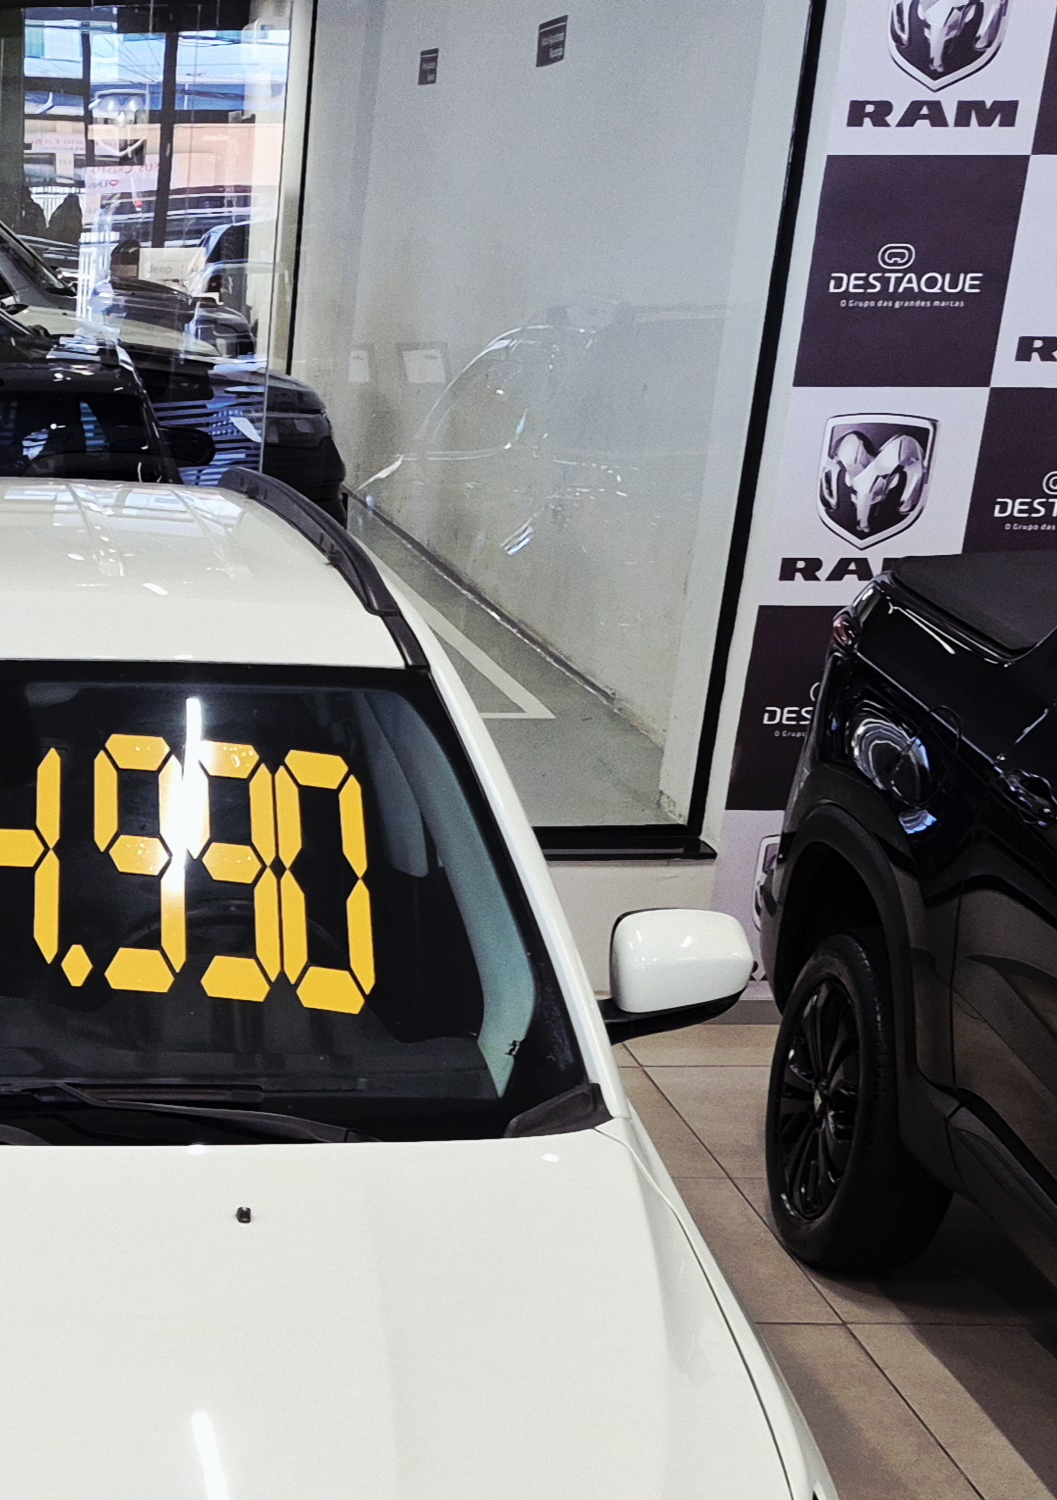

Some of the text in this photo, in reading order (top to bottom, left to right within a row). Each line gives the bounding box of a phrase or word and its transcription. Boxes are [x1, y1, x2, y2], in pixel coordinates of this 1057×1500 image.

[846, 100, 1020, 127] RAM
[828, 272, 983, 293] DESTAQUE
[848, 300, 875, 309] Grupo
[877, 300, 893, 308] das
[894, 300, 931, 309] grandes
[1013, 523, 1039, 532] Grupo
